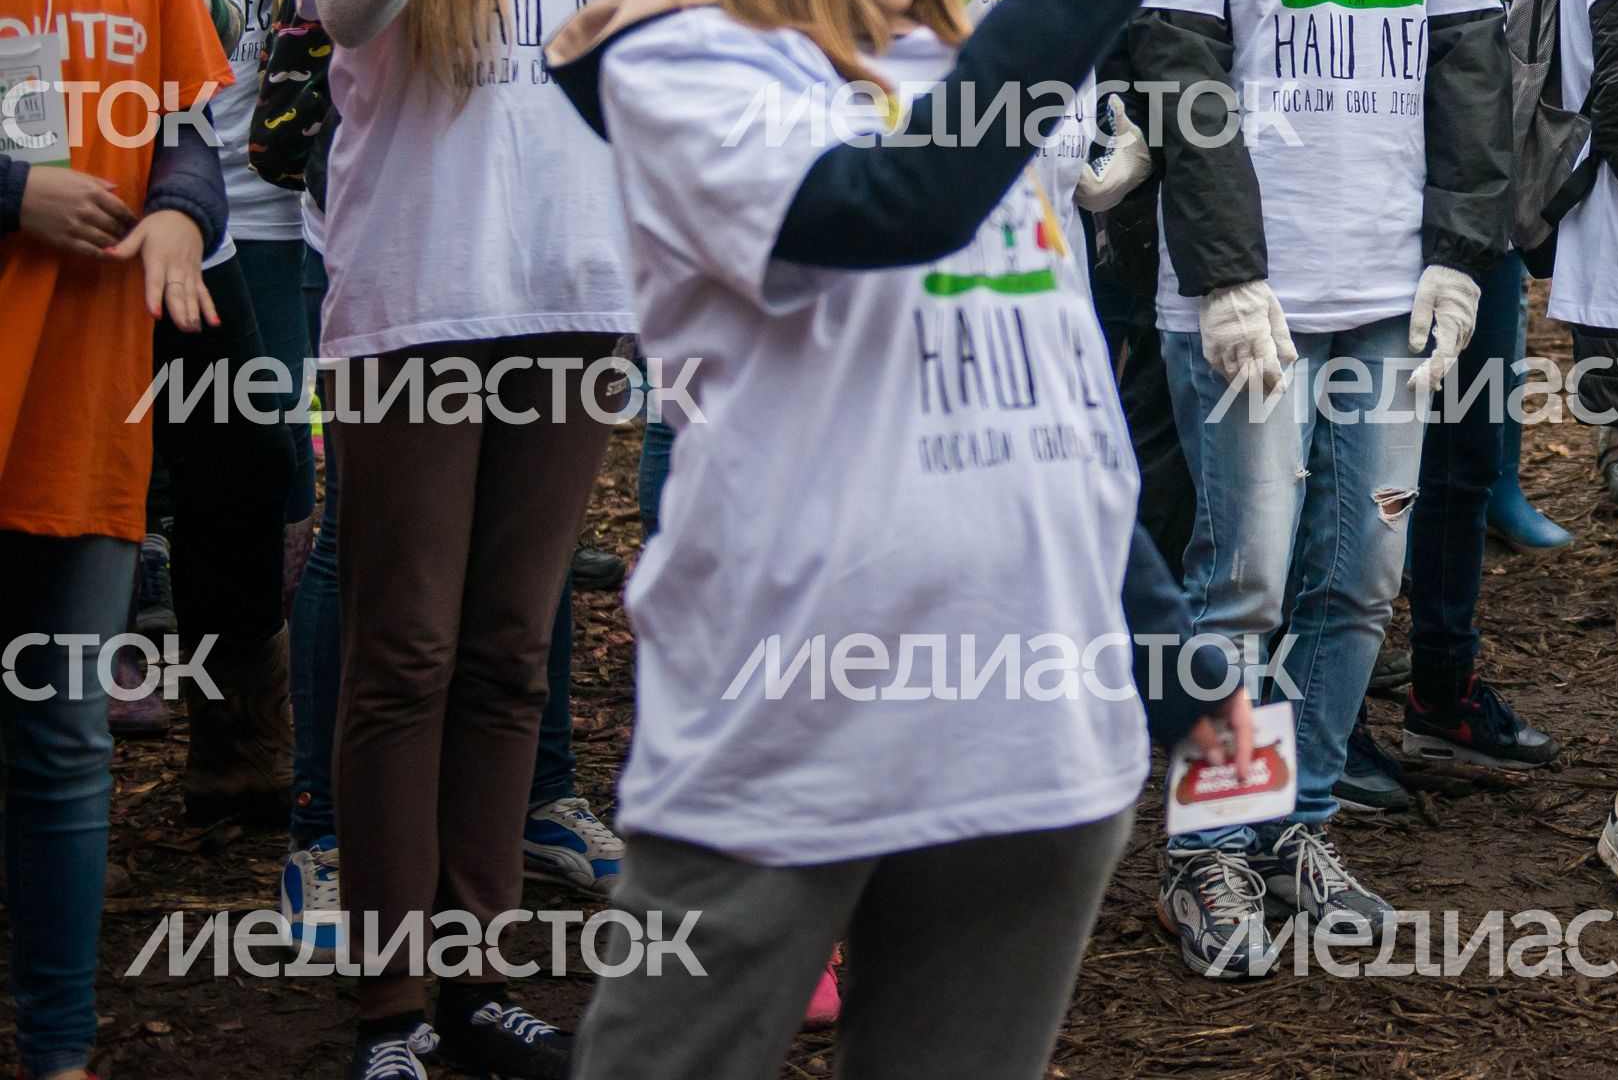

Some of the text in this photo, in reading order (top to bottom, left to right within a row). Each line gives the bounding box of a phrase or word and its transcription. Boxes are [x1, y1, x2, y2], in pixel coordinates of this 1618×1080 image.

[1273, 12, 1355, 80] НАШ
[1273, 88, 1334, 114] ПОСАДИ
[1346, 90, 1378, 114] СВОЕ
[913, 305, 1037, 415] НАШ
